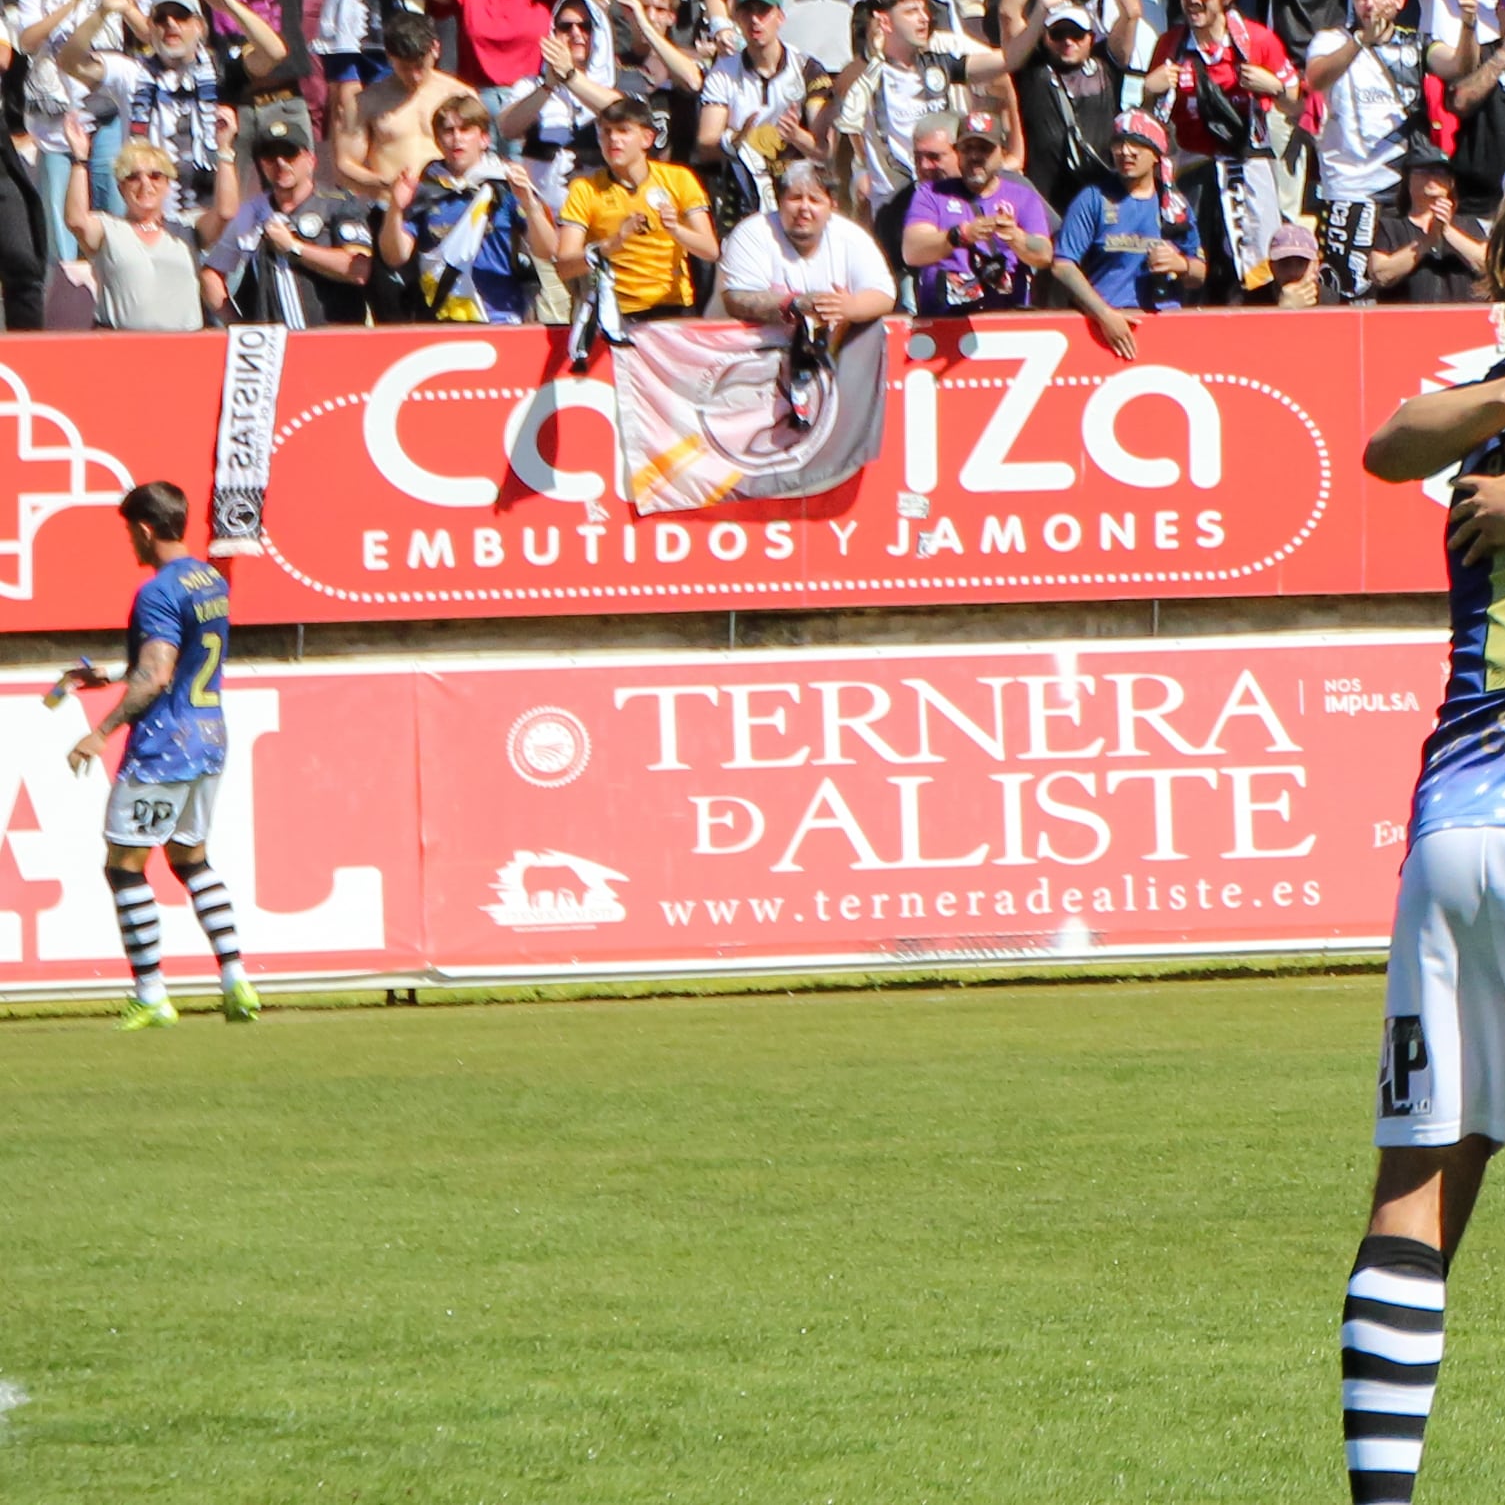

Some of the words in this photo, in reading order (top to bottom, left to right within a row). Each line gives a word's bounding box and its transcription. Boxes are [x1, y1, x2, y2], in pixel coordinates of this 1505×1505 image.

[363, 521, 792, 571] EMBUTIDOS
[831, 520, 857, 556] Y
[886, 510, 1226, 557] JAMONES
[189, 632, 223, 708] 2
[1324, 678, 1362, 693] NOS
[614, 669, 1304, 771] TERNERA
[770, 765, 1318, 872] ALISTE
[659, 876, 1322, 927] www.terneradealiste.es
